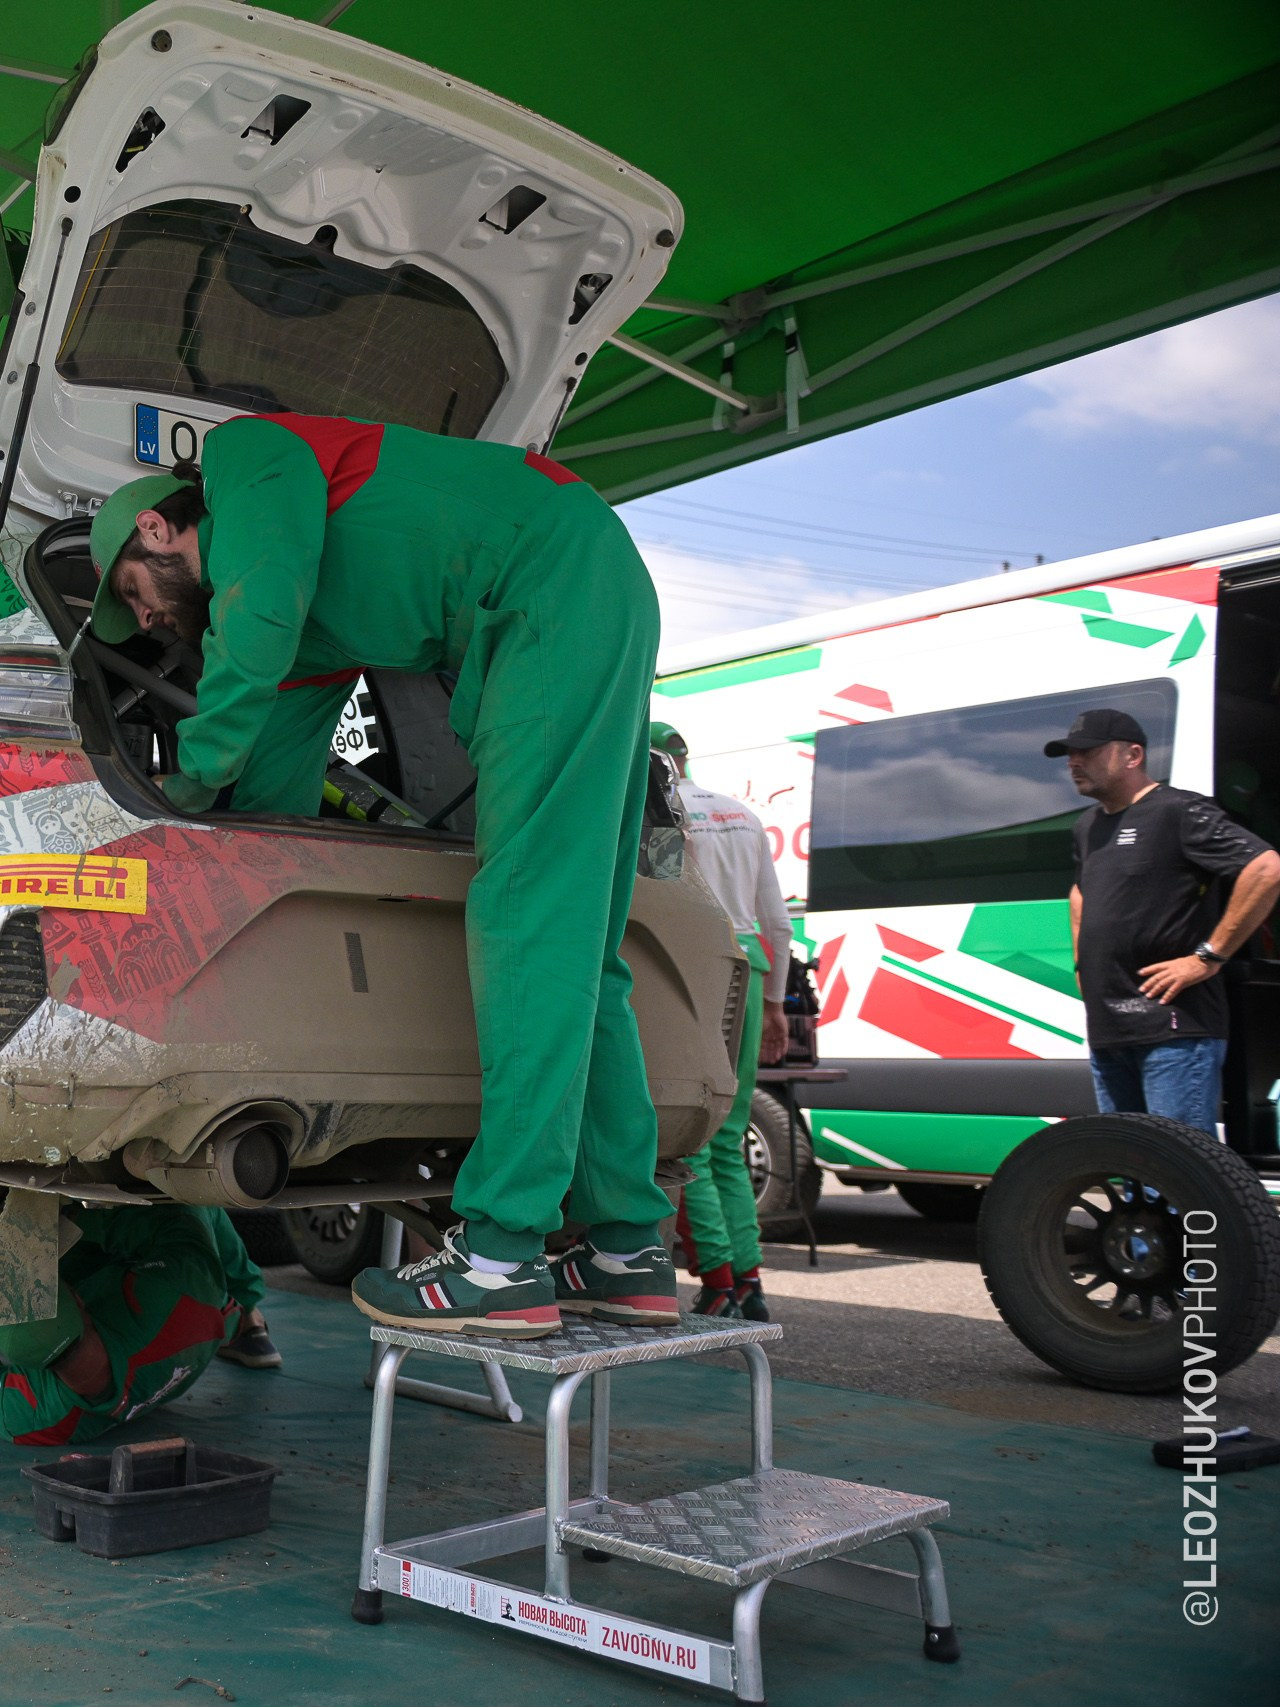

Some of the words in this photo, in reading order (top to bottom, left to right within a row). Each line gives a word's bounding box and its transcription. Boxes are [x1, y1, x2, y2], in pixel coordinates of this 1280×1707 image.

[139, 441, 156, 455] LV
[518, 1601, 547, 1624] НОВАЯ
[549, 1610, 587, 1636] ВЫСОТА
[602, 1626, 697, 1670] ZAVODNV.RU
